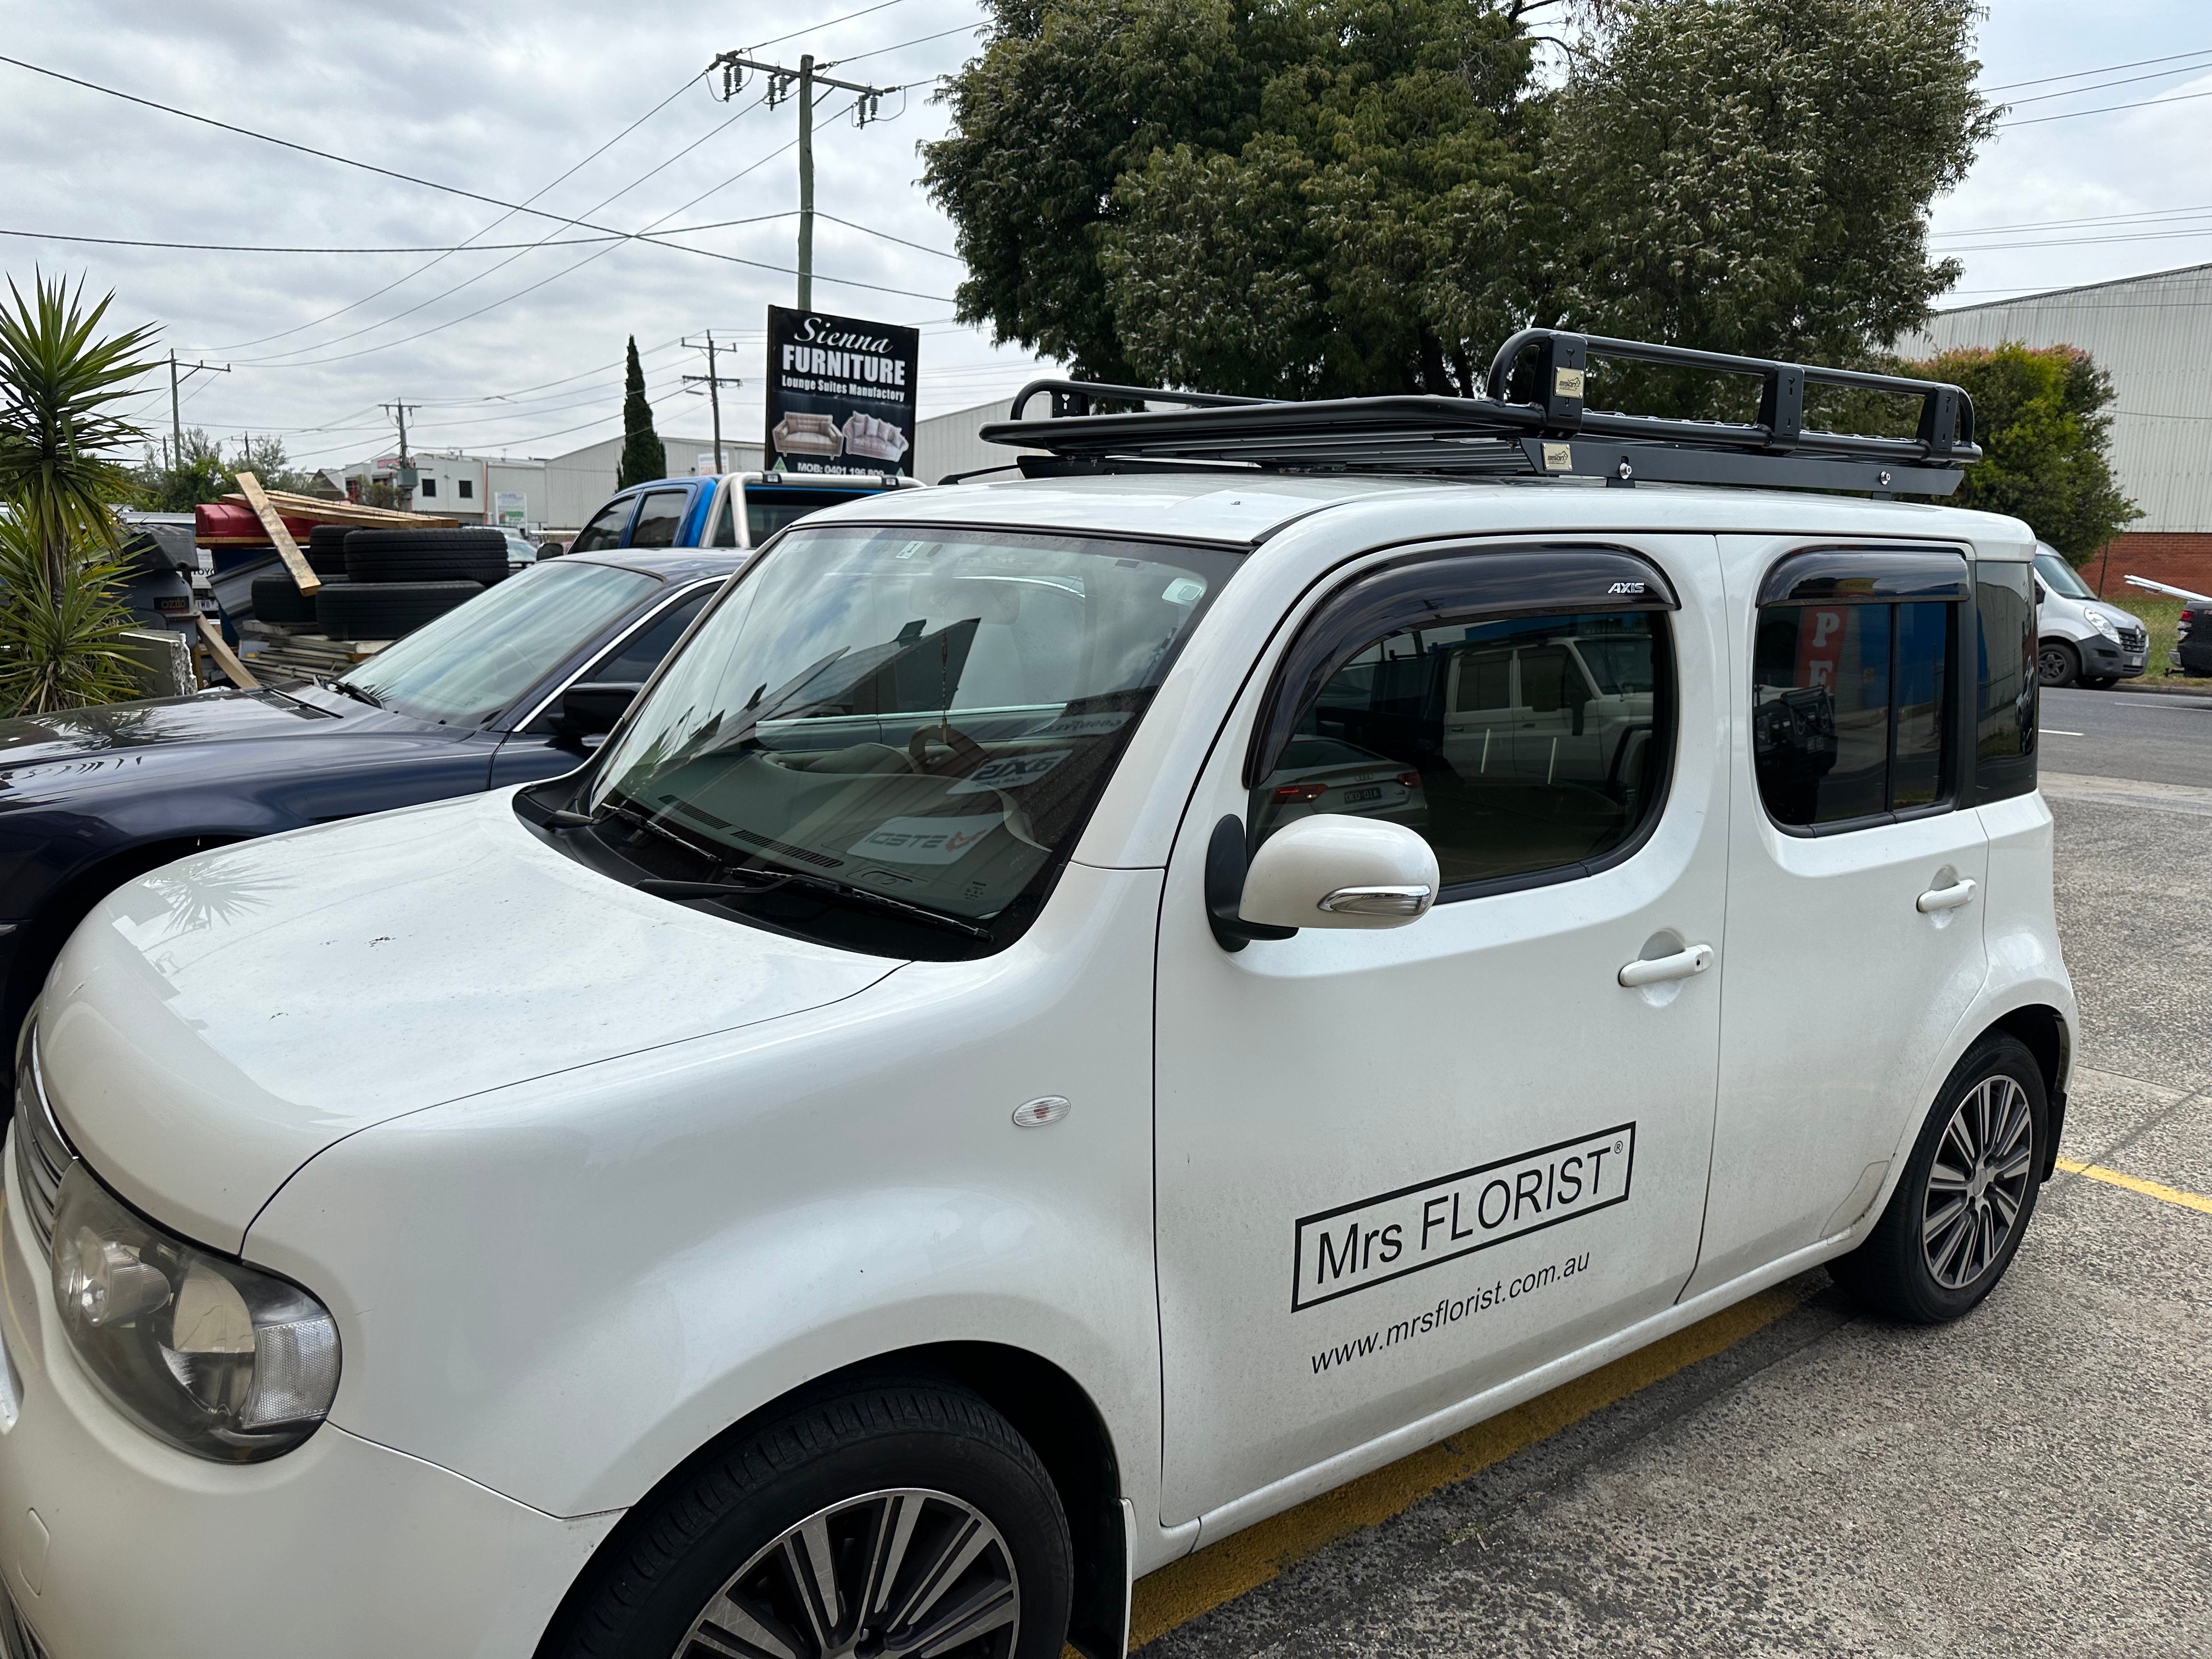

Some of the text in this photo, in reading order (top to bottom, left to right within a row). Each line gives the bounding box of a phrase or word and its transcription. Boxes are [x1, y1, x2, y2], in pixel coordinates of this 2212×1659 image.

[794, 317, 894, 353] Sienna
[782, 344, 906, 385] FURNITURE
[781, 374, 905, 402] Lounge Suites Manufactory
[797, 462, 823, 473] MOB:
[825, 466, 847, 475] 0401
[850, 467, 865, 476] 196
[1607, 583, 1645, 594] AXIS
[1317, 1223, 1402, 1284] Mrs
[1311, 1252, 1590, 1374] www.mrsflorist.com.au
